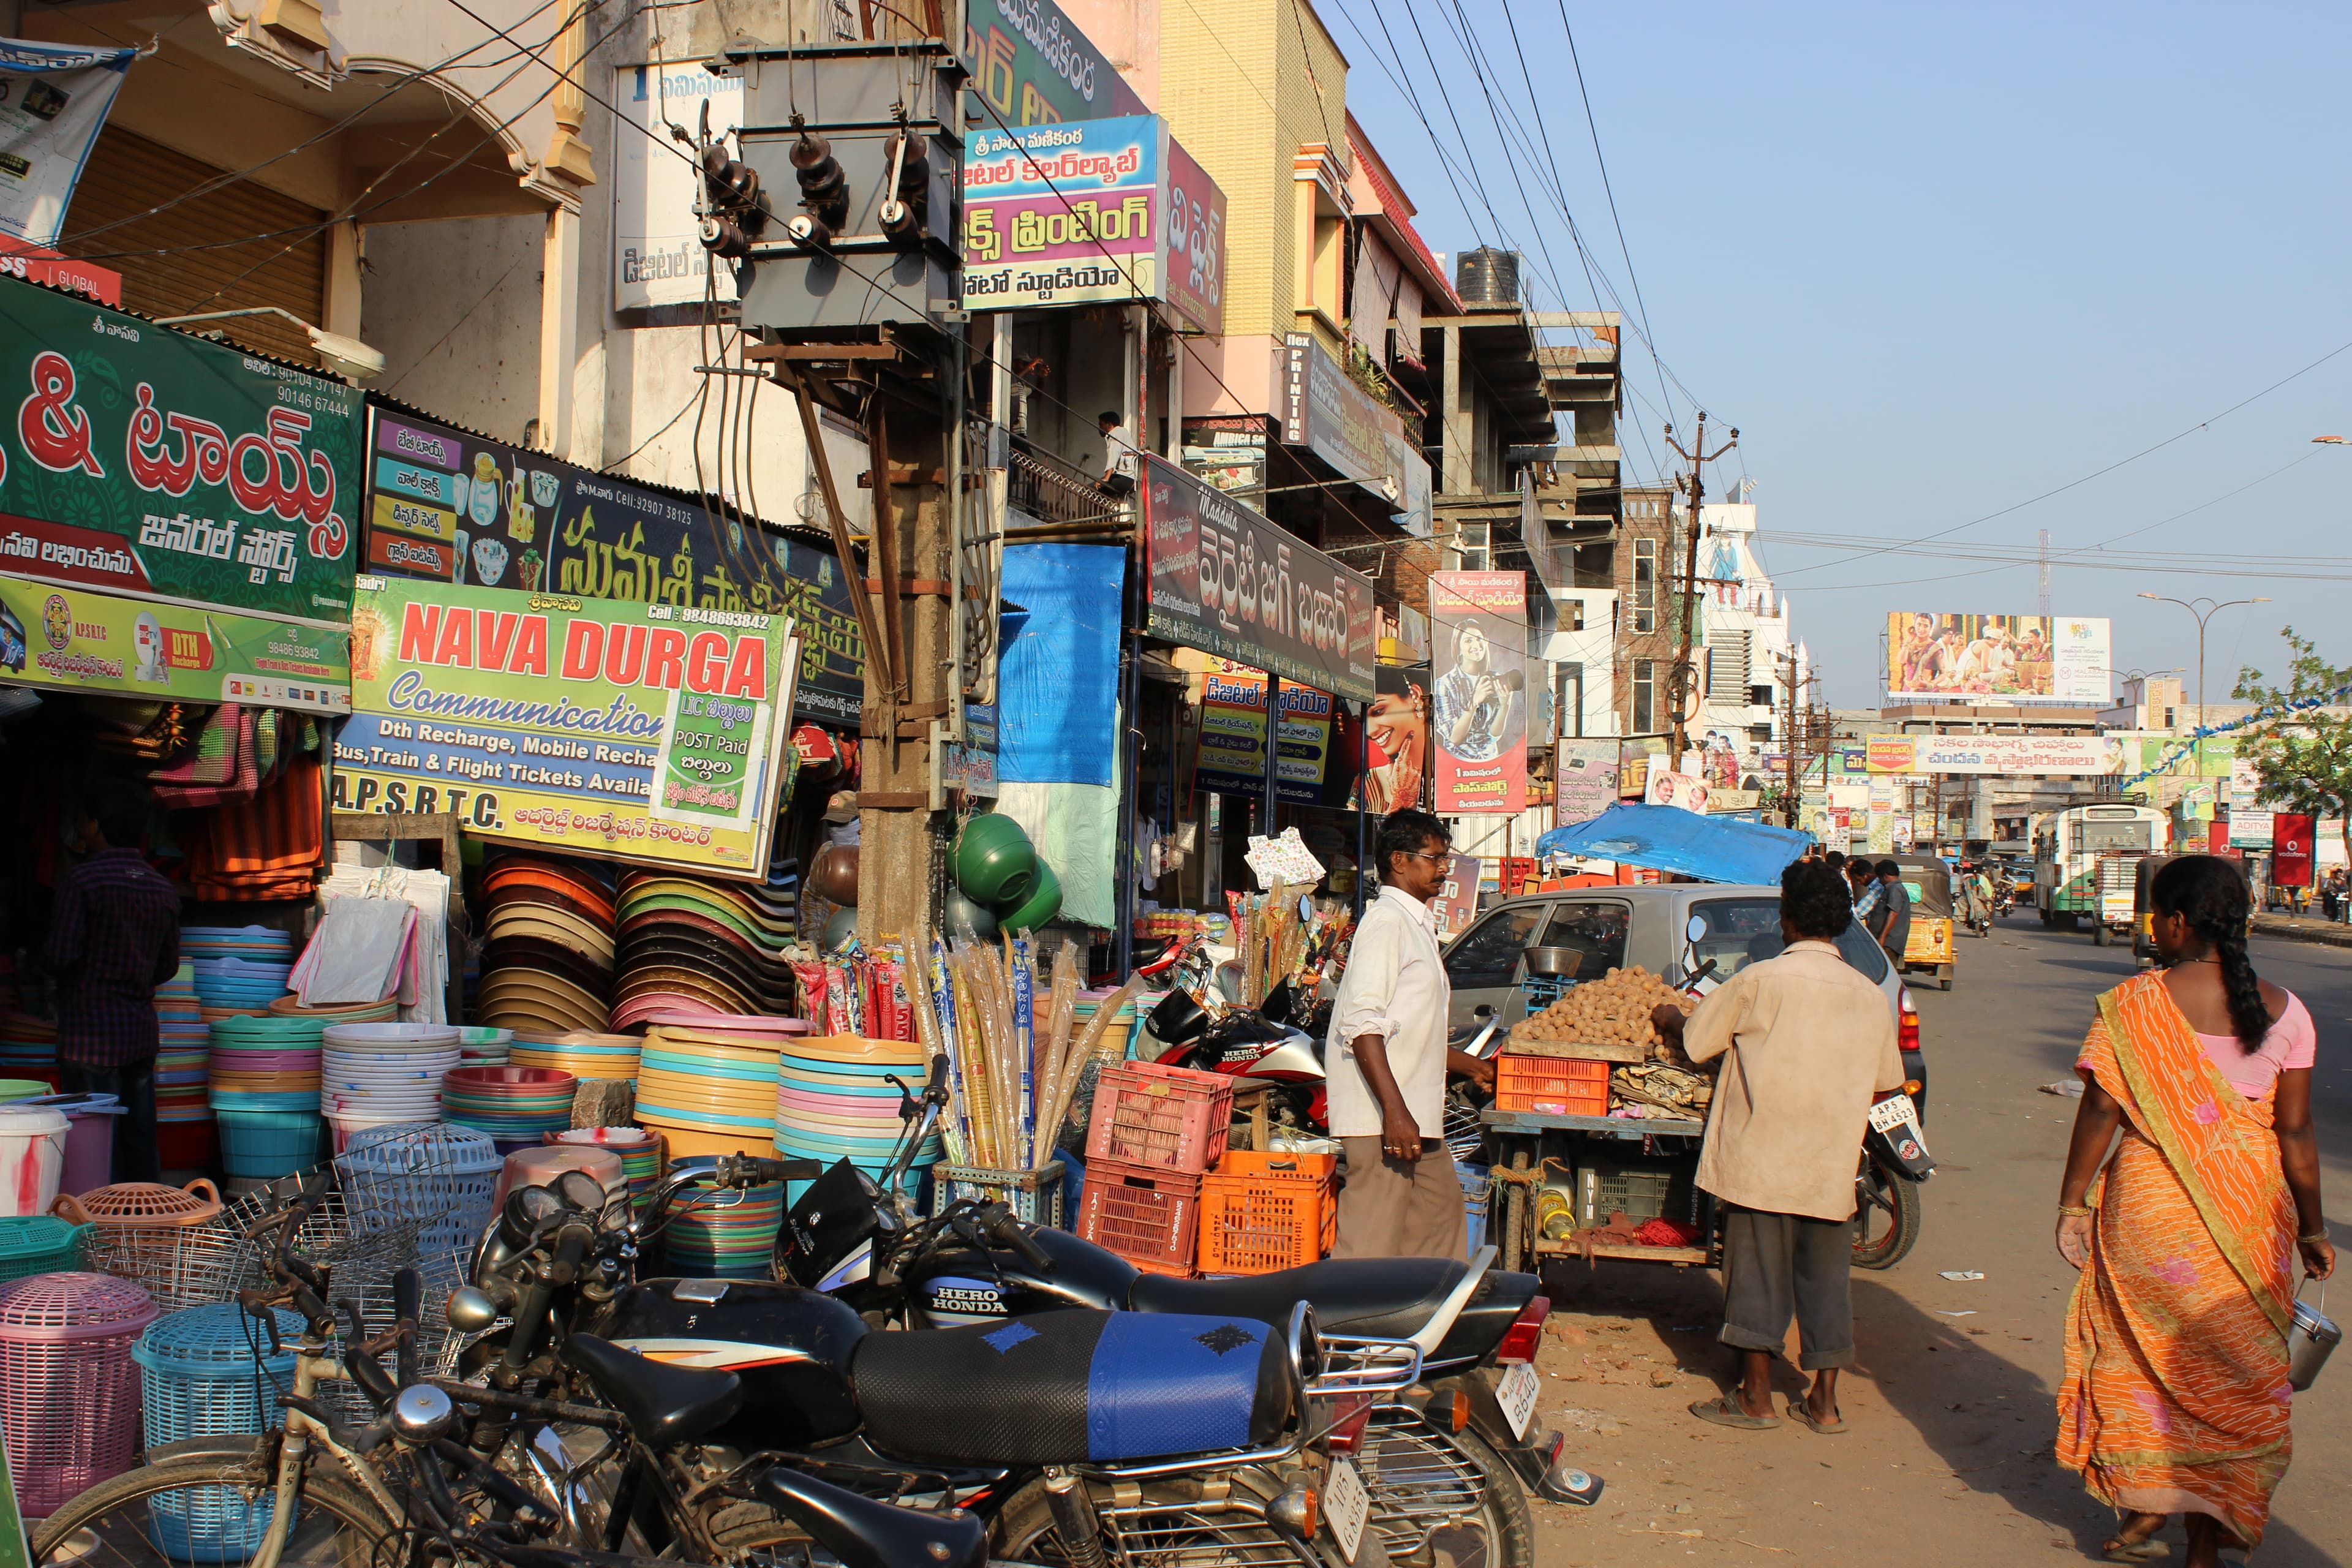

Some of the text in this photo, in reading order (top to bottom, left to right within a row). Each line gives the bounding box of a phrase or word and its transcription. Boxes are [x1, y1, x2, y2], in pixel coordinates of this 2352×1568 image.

[59, 270, 100, 296] GLOBAL
[92, 315, 105, 335] శ్రీ
[279, 367, 312, 387] 90104
[316, 377, 348, 397] 37147
[278, 386, 349, 418] 90146 67444
[1288, 349, 1303, 441] PRINTING
[18, 350, 106, 479] &
[666, 505, 692, 524] 38125
[647, 604, 770, 630] Cell 9848693842
[172, 633, 198, 657] DTH
[268, 641, 319, 660] 98486 93842
[398, 601, 549, 678] NAVA
[560, 619, 767, 701] DURGA
[172, 655, 201, 668] Recharge
[680, 696, 704, 715] LIC
[380, 719, 413, 740] Dth
[418, 723, 516, 755] Recharge,
[522, 736, 589, 760] Mobile
[674, 730, 748, 755] POST Paid
[426, 754, 441, 771] &
[447, 756, 503, 782] Flight
[509, 763, 583, 789] Tickets
[1455, 767, 1461, 777] 1
[1016, 972, 1028, 1023] NOKIA
[1221, 1054, 1261, 1062] HONDA
[1224, 1048, 1257, 1057] HERO
[1891, 1107, 1914, 1123] 4523
[1586, 1173, 1594, 1220] NYM
[1086, 1220, 1095, 1241] VZA
[932, 1298, 1008, 1313] HONDA
[938, 1287, 999, 1302] HERO
[1514, 1371, 1536, 1425] 8640
